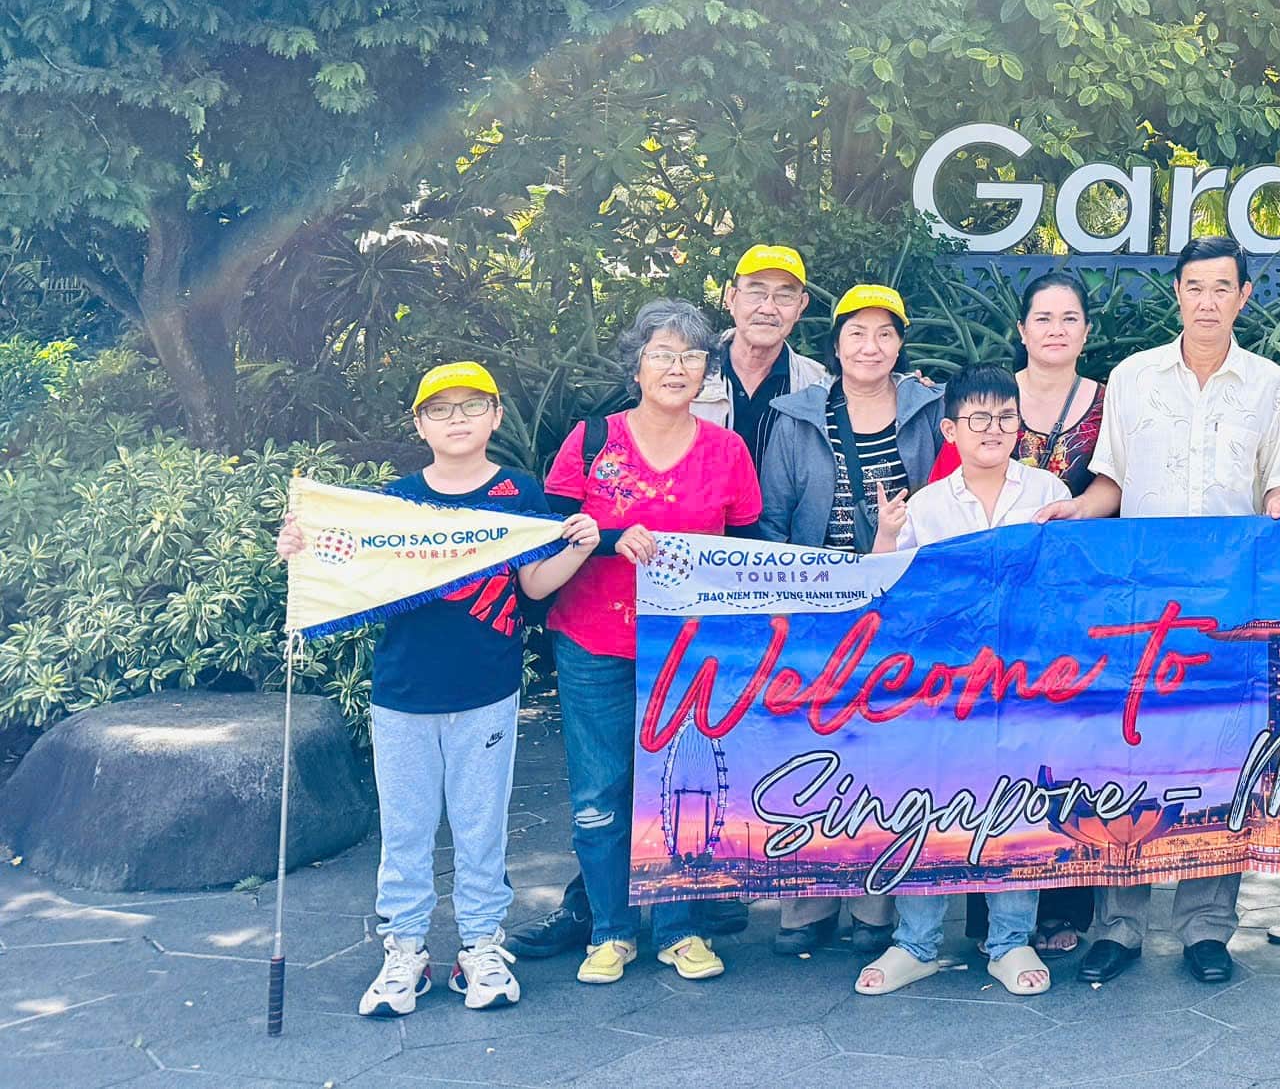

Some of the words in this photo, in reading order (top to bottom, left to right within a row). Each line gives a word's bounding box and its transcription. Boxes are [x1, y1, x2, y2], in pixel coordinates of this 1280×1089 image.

[360, 534, 405, 549] NGOI
[409, 532, 447, 546] SAO
[451, 527, 509, 544] GROUP
[394, 547, 477, 559] TOURISM
[699, 550, 749, 566] NGOI
[752, 551, 796, 566] SAO
[736, 570, 830, 583] TOURISM
[752, 591, 769, 600] TIN
[639, 608, 1107, 752] Welcome
[751, 748, 1148, 896] Singapore
[1164, 784, 1202, 807] -
